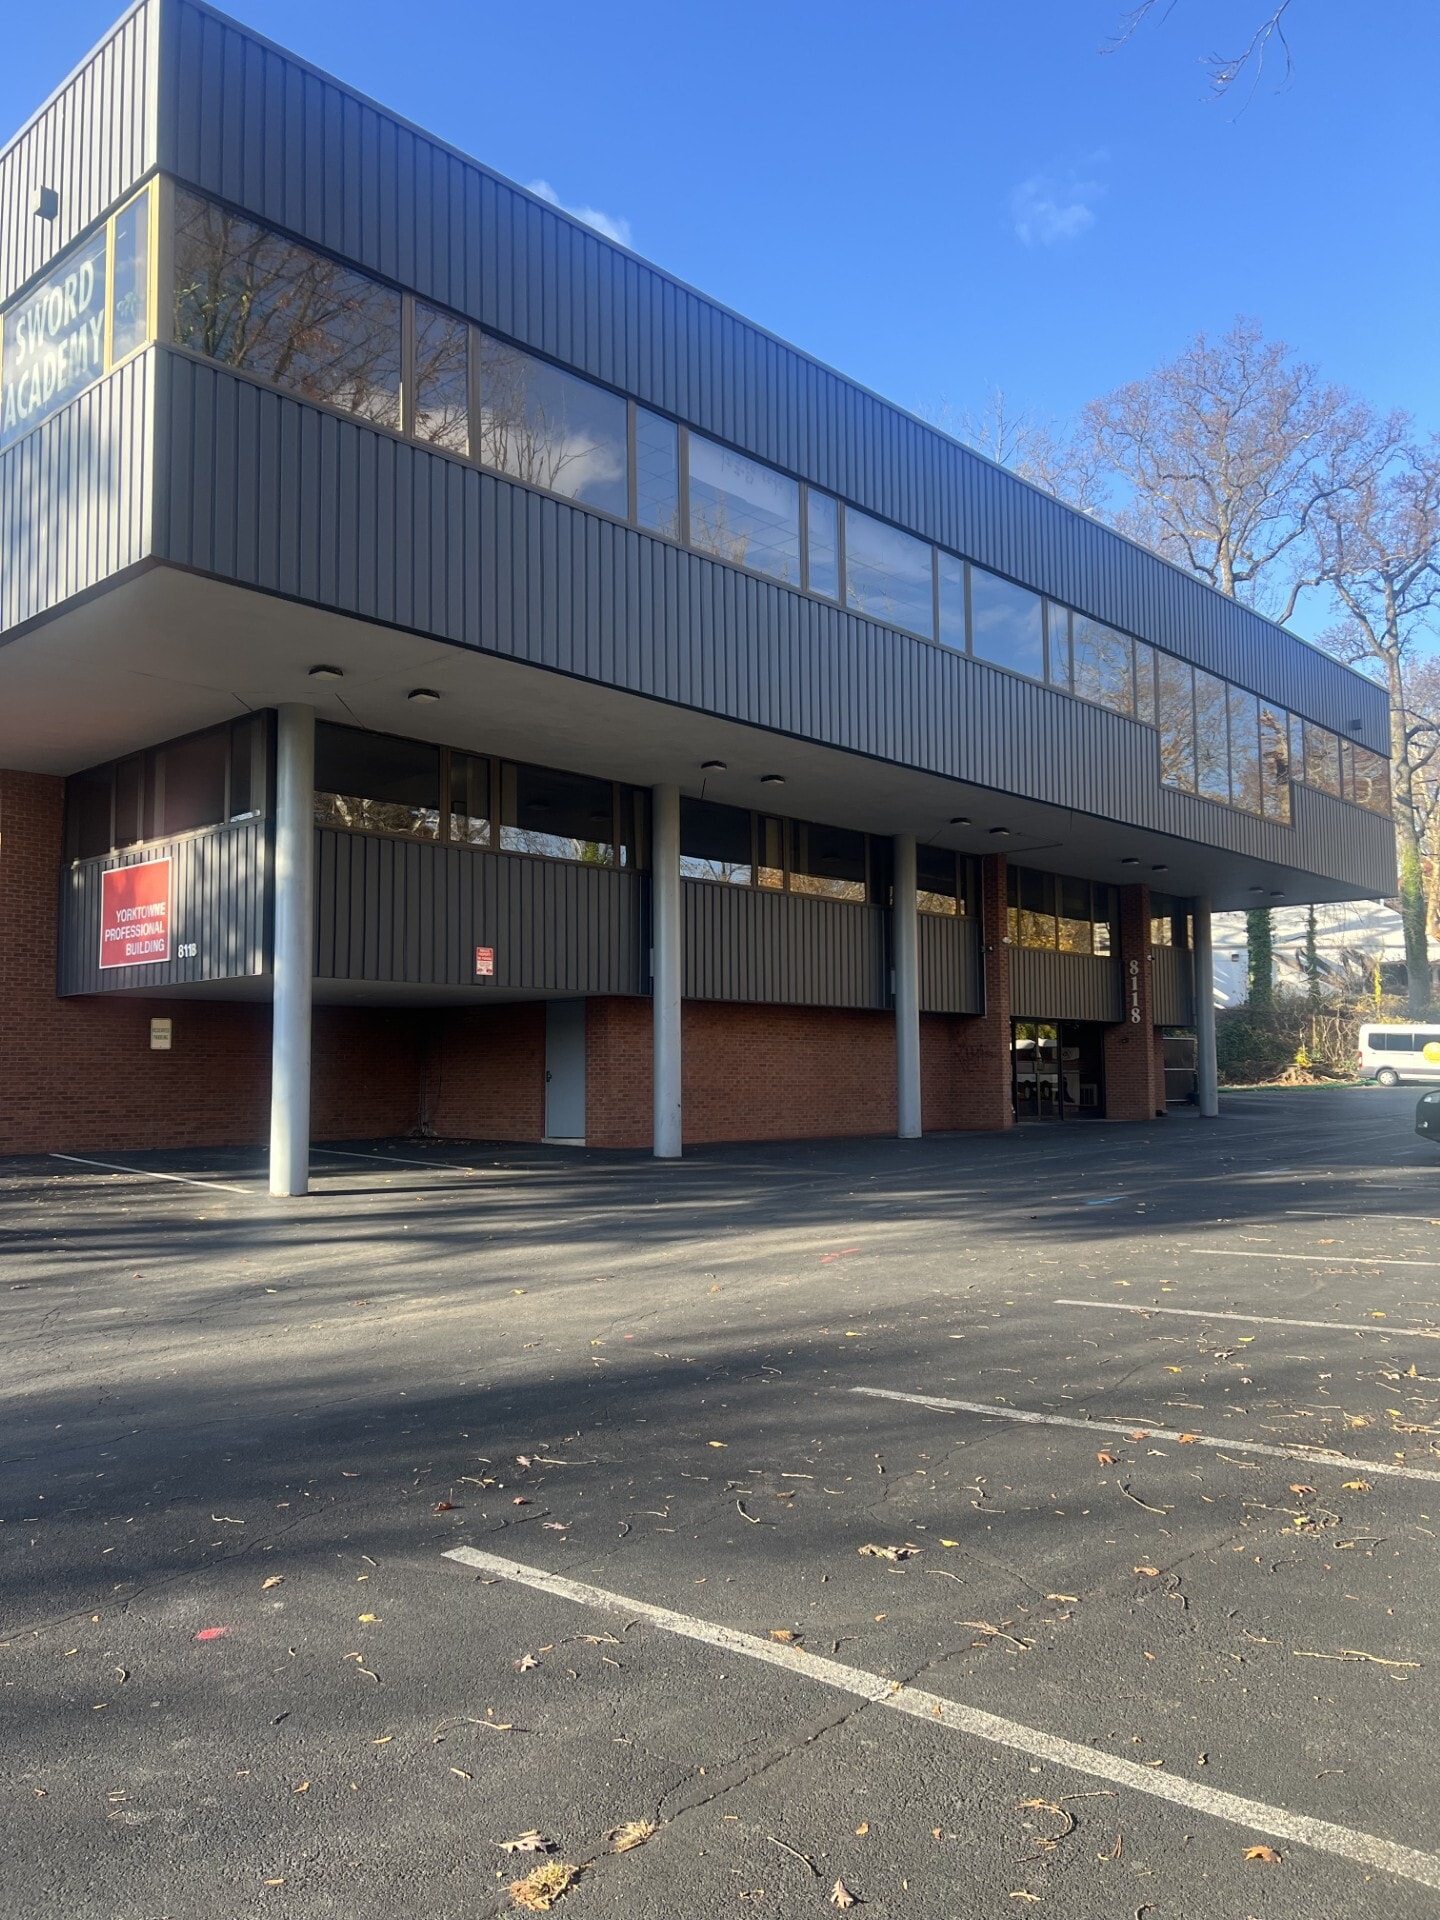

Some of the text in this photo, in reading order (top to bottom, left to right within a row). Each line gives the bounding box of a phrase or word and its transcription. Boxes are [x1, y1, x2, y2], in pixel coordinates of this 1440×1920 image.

[15, 260, 95, 366] SWORD
[3, 308, 104, 433] ACADEMY
[116, 902, 166, 923] YORKTOWNE
[105, 921, 165, 942] PROFESSIONAL
[126, 938, 165, 956] BUILDING
[178, 943, 197, 958] 8118
[1129, 960, 1141, 1024] 8118
